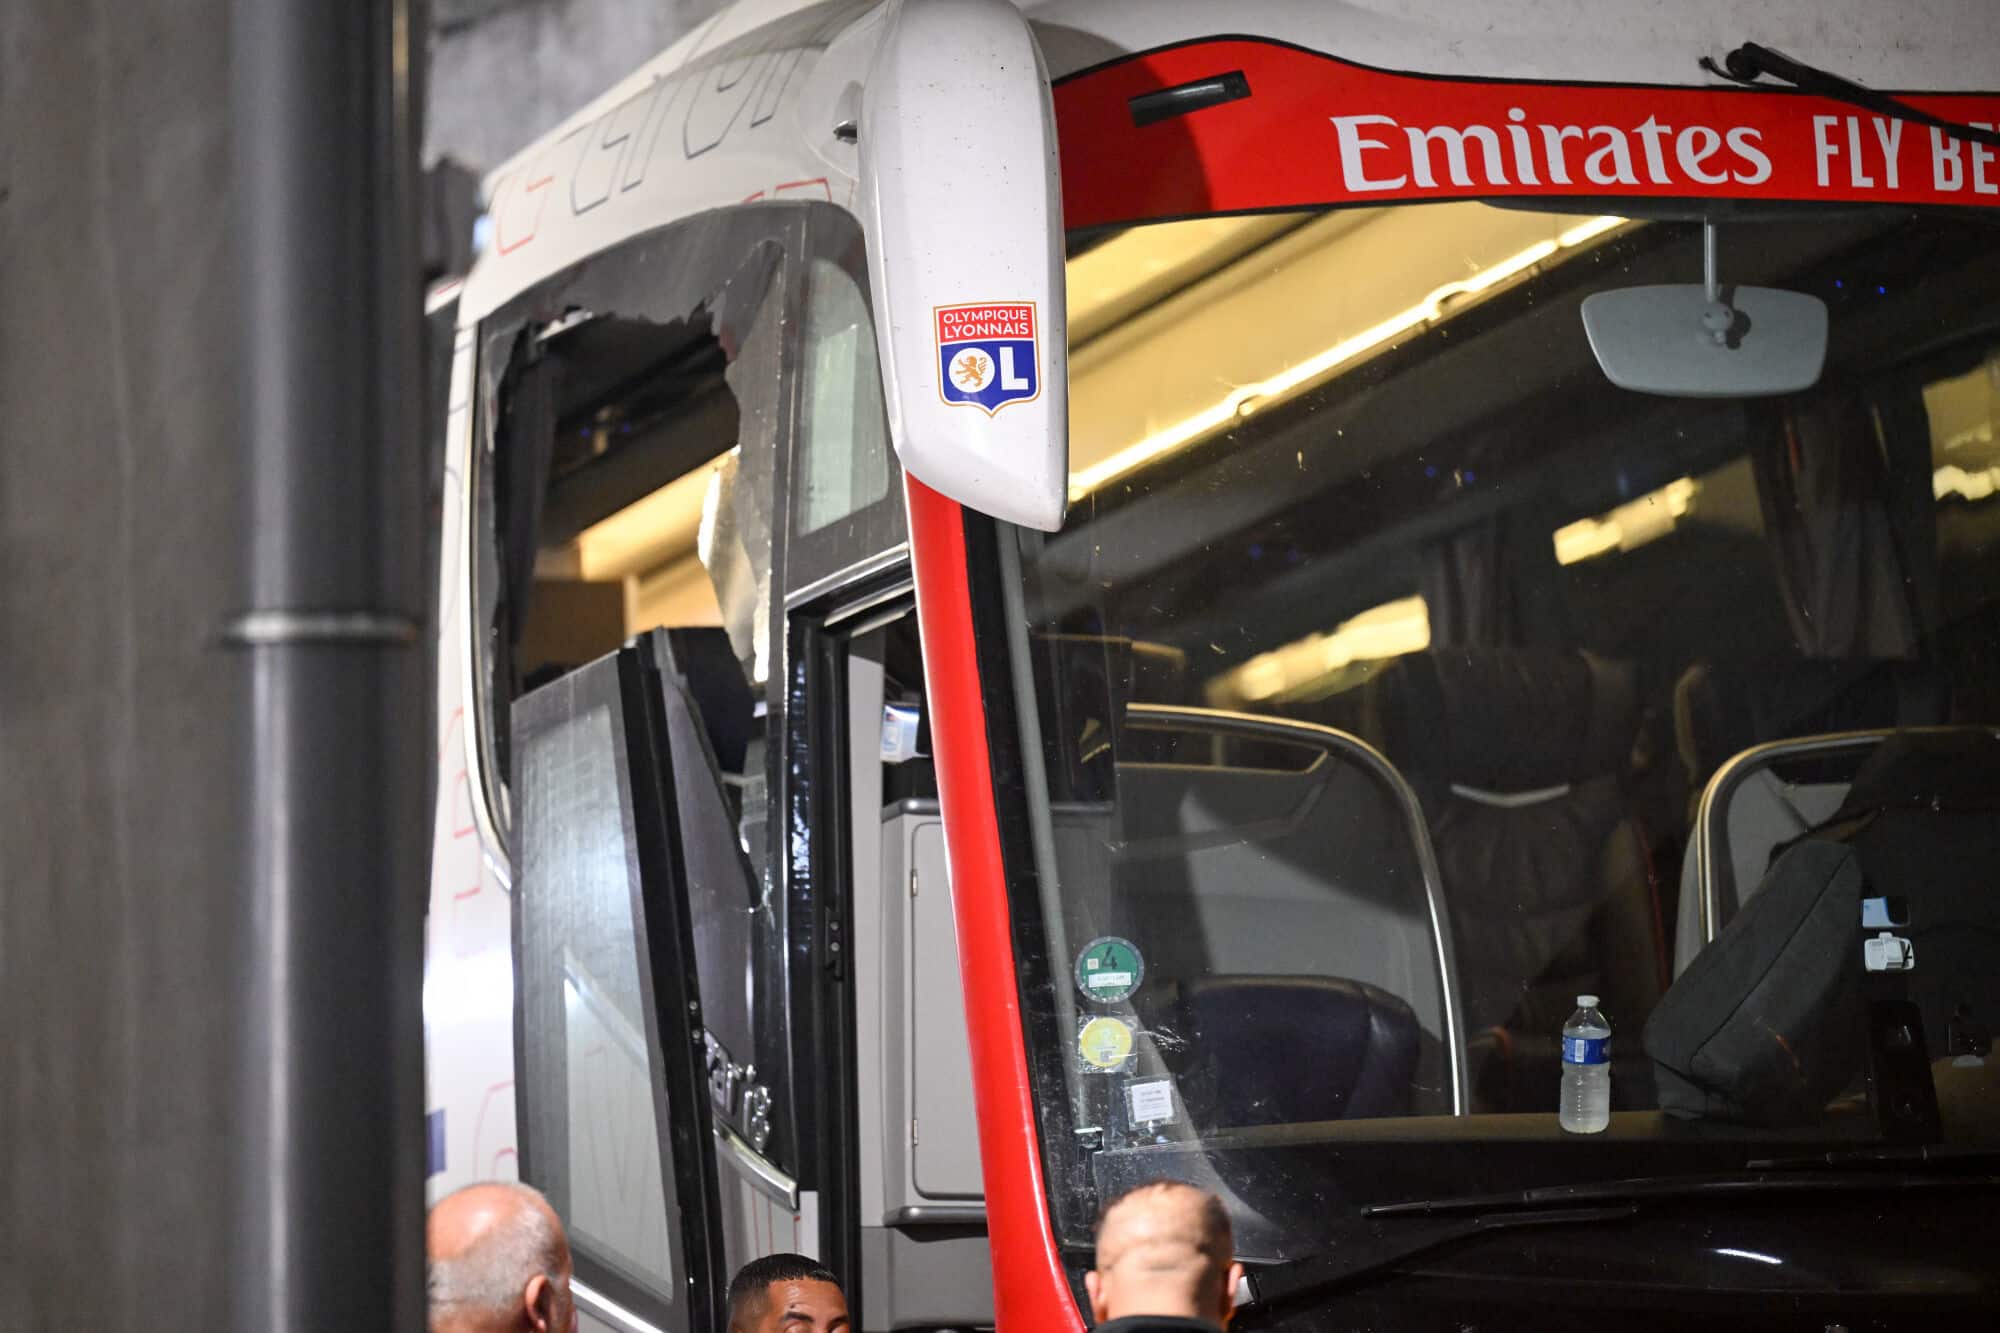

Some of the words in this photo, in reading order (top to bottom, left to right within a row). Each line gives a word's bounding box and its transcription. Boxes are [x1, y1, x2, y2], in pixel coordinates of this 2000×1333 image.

[1330, 107, 1772, 192] Emirates
[1813, 115, 1903, 189] FLY
[1929, 121, 2000, 194] BE
[943, 309, 1028, 324] OLYMPIQUE
[944, 322, 1029, 338] LYONNAIS
